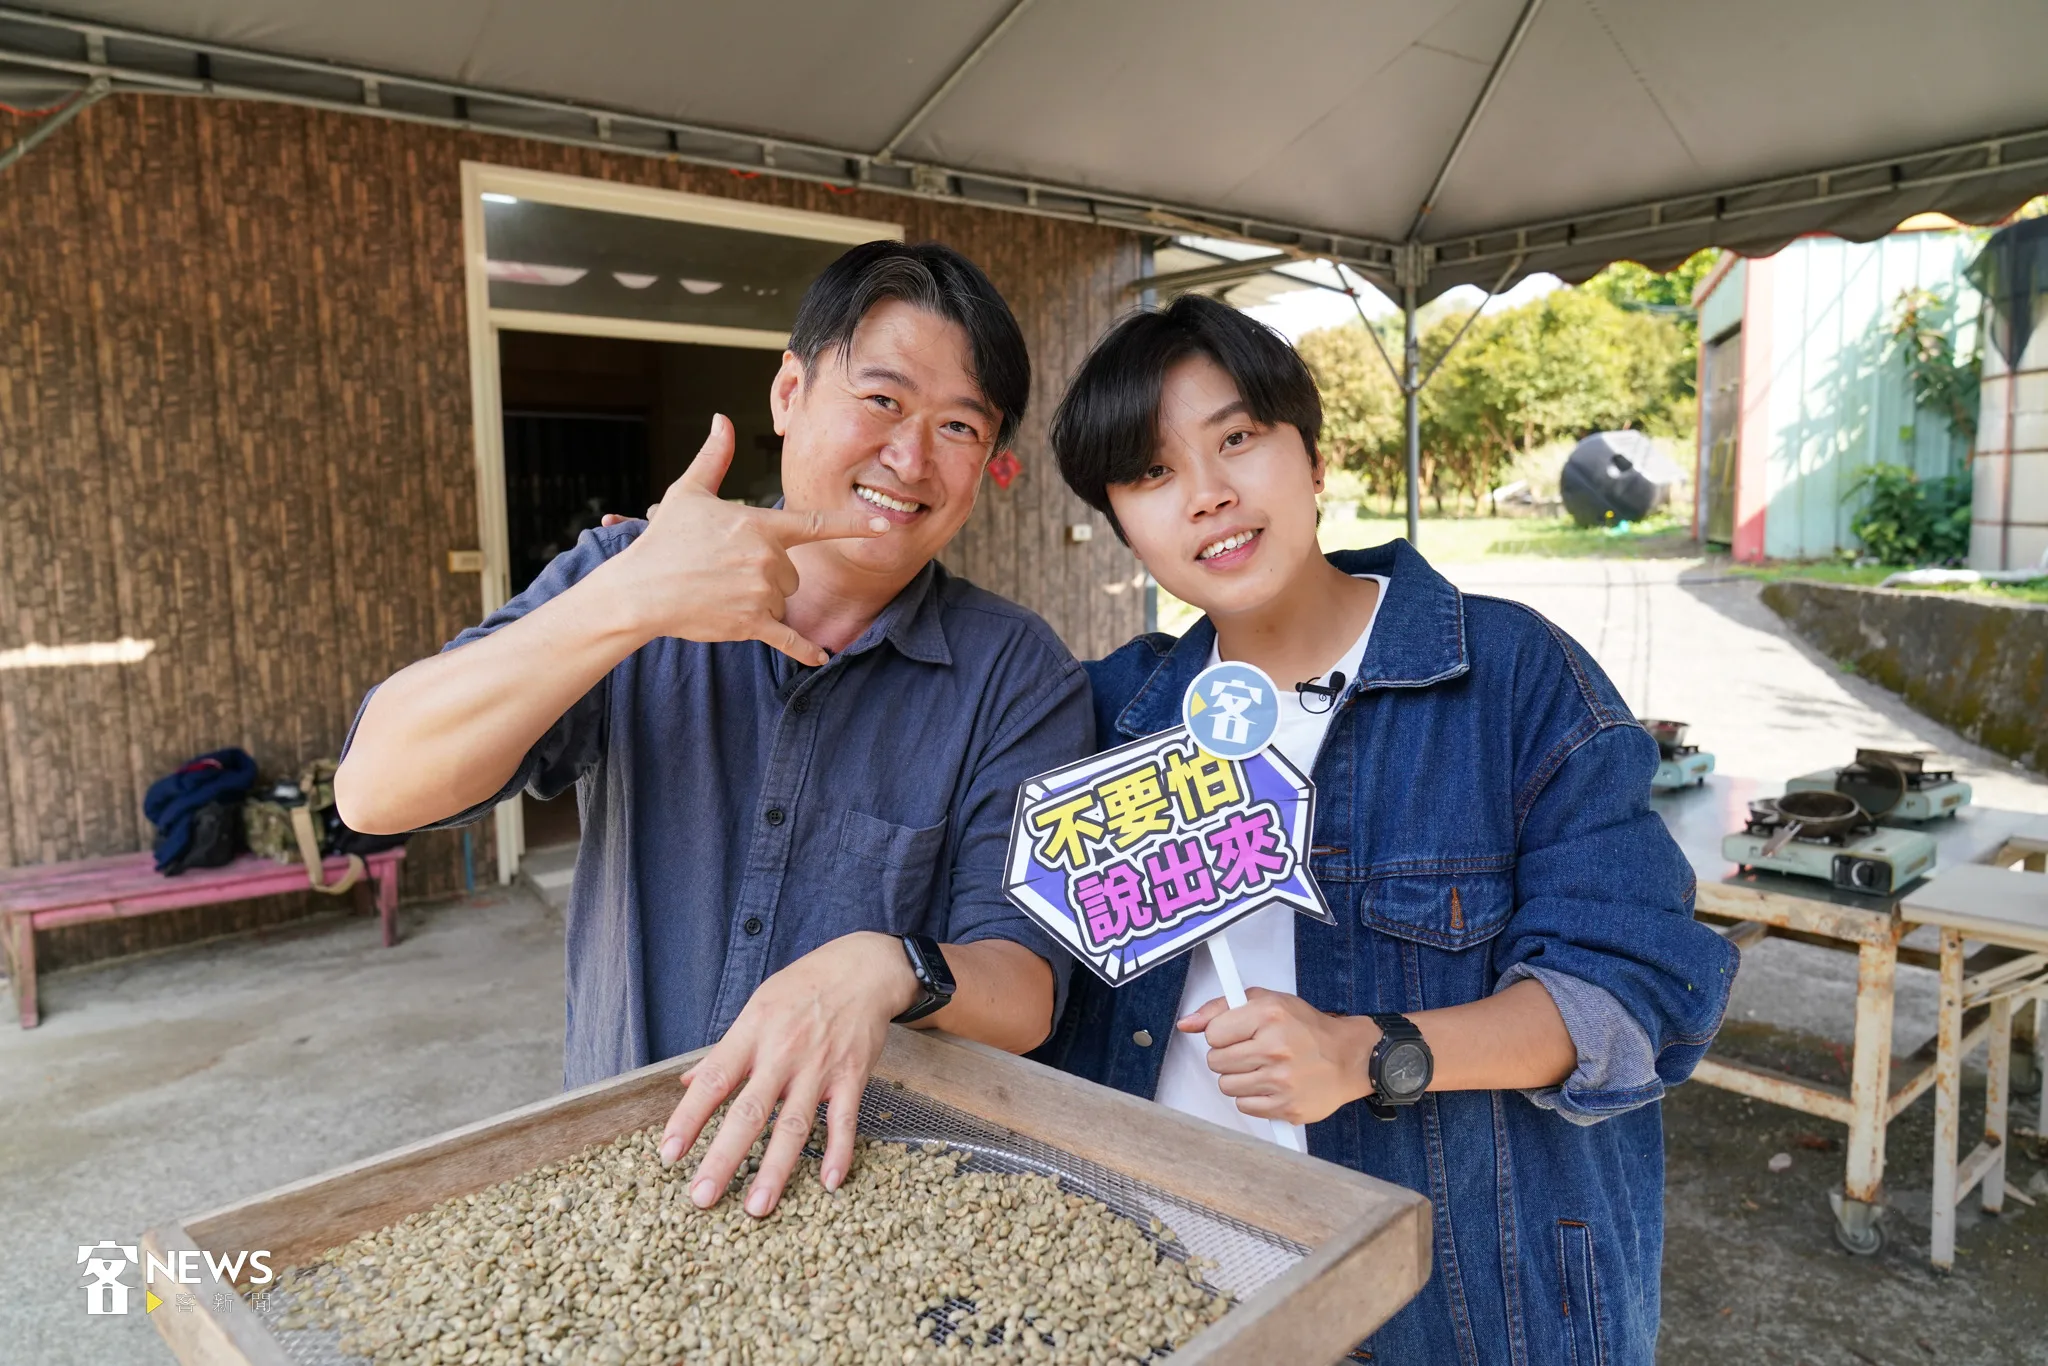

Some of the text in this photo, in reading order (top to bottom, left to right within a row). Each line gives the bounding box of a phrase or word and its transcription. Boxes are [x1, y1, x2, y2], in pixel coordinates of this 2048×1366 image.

[1035, 749, 1244, 866] 不要怕
[1078, 813, 1286, 943] 說出來
